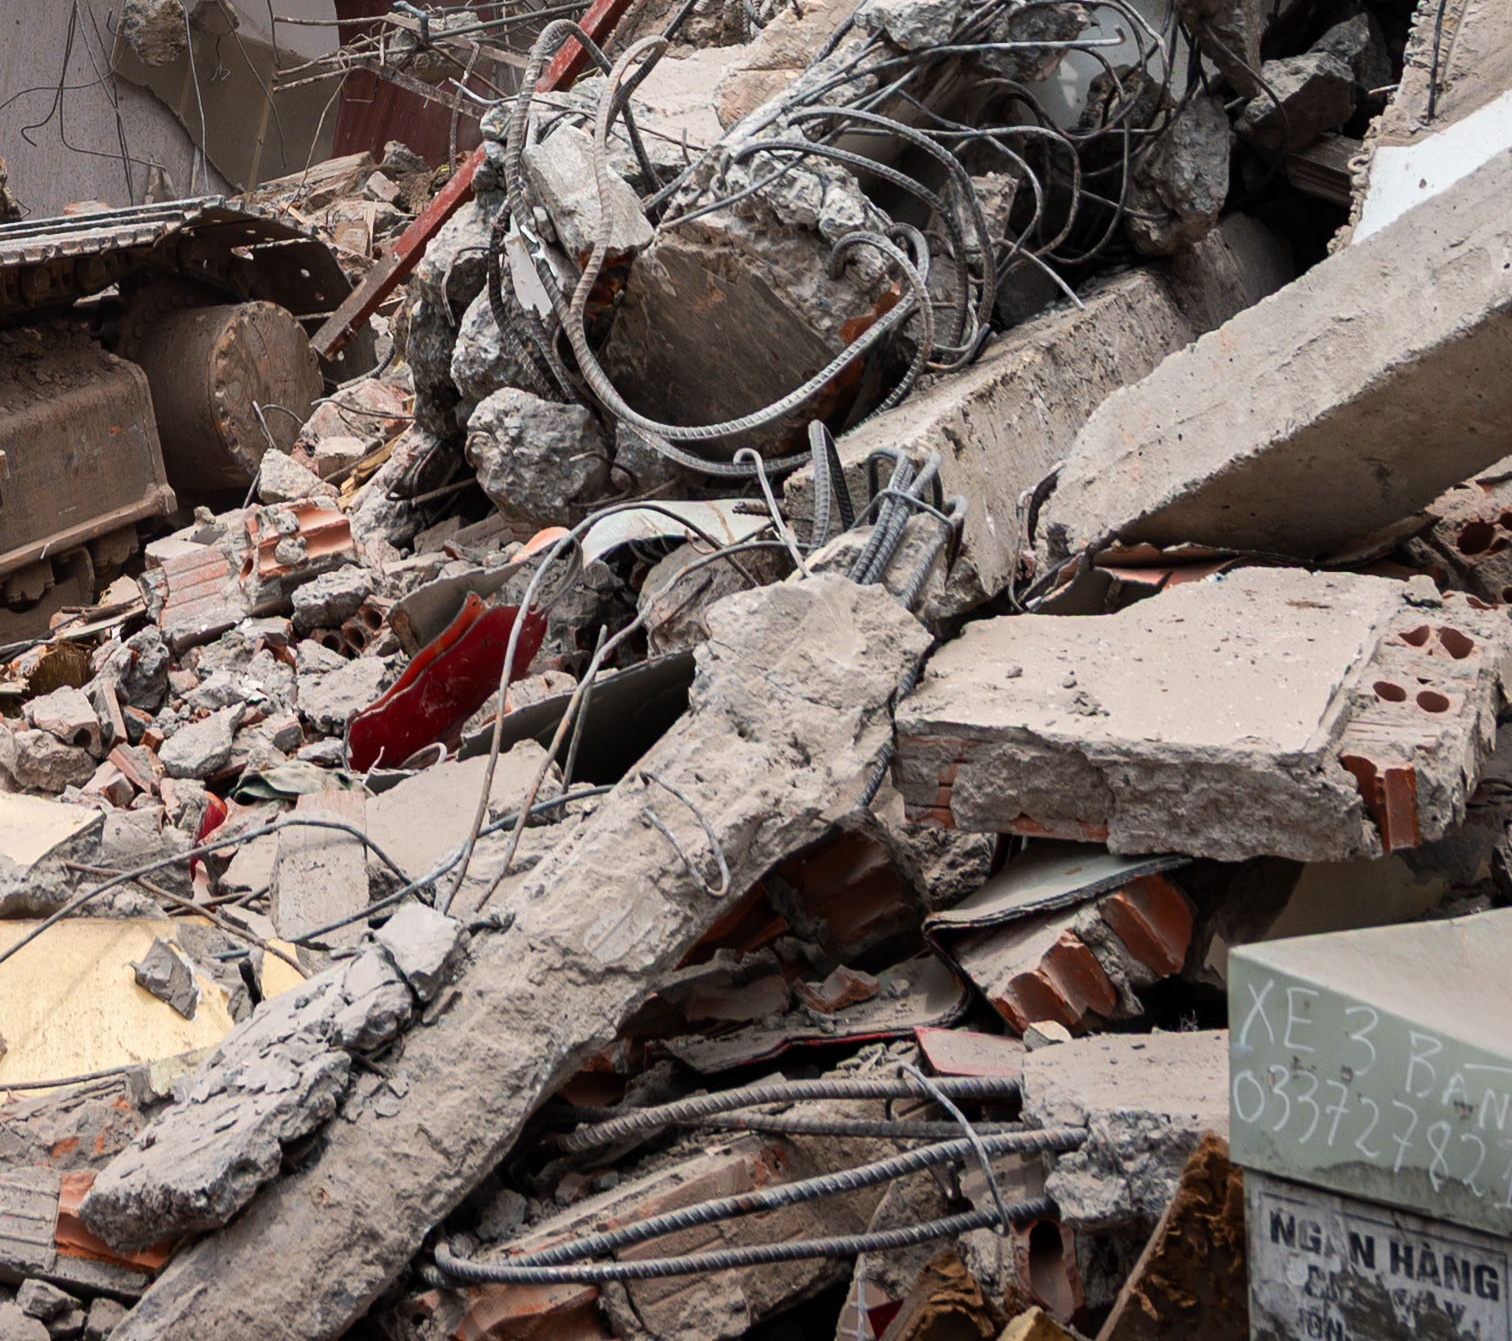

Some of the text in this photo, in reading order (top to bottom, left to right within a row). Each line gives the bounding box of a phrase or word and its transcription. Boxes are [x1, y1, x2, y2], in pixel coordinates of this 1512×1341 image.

[1239, 980, 1319, 1053] XE
[1344, 1006, 1379, 1077] 3
[1269, 1210, 1375, 1270] NGN
[1389, 1239, 1501, 1302] HÀNG
